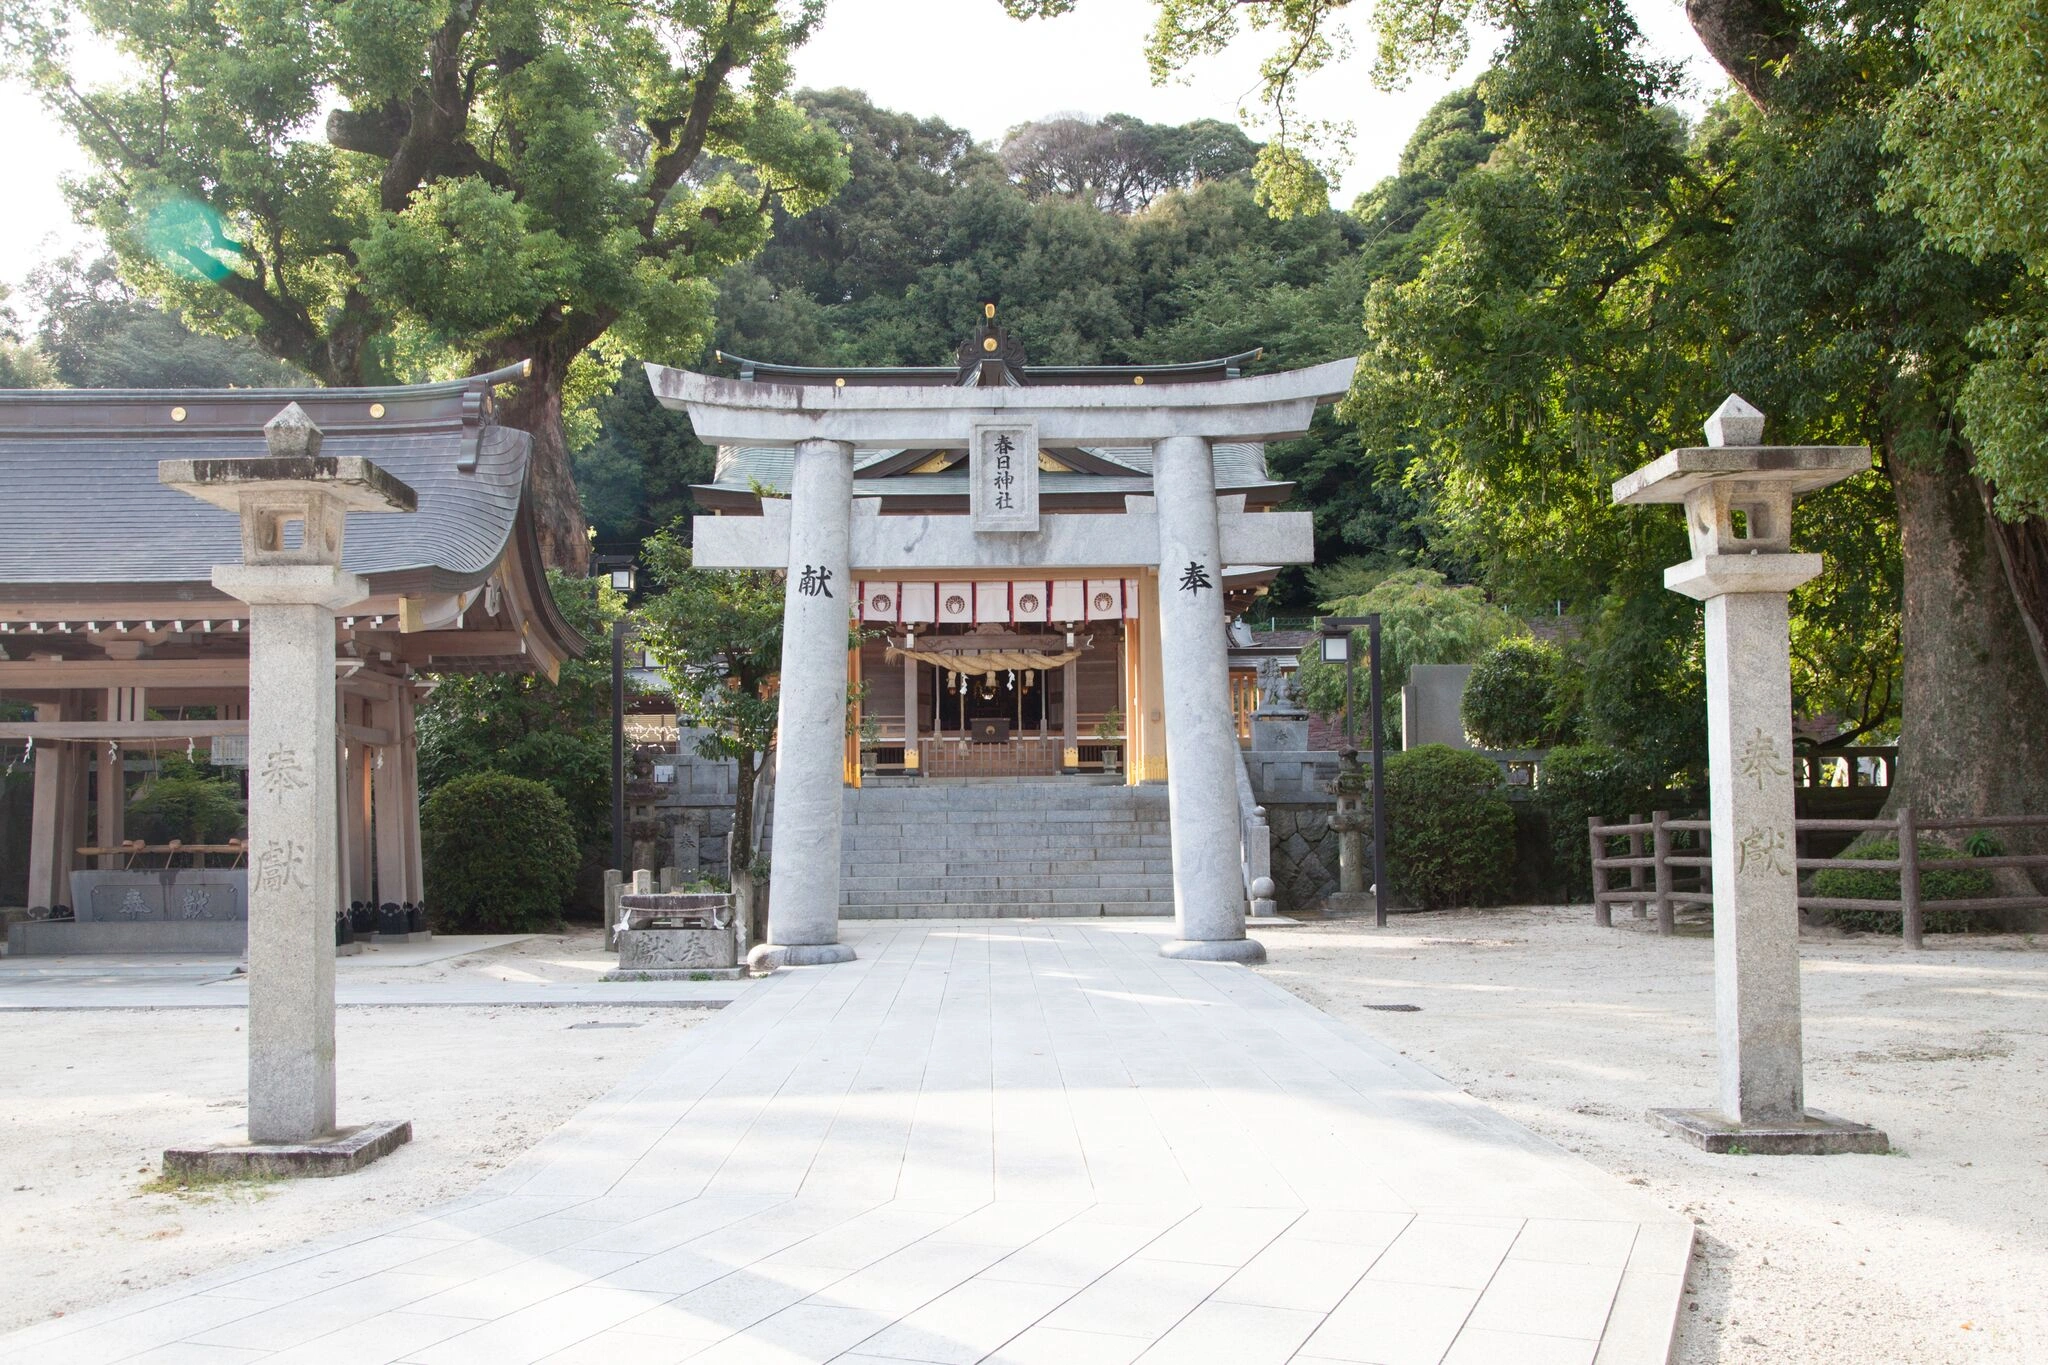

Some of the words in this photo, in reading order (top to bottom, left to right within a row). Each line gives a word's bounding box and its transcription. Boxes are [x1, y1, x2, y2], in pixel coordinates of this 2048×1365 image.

[994, 434, 1015, 510] 春日神社
[798, 564, 833, 599] 献
[1179, 561, 1213, 597] 奉
